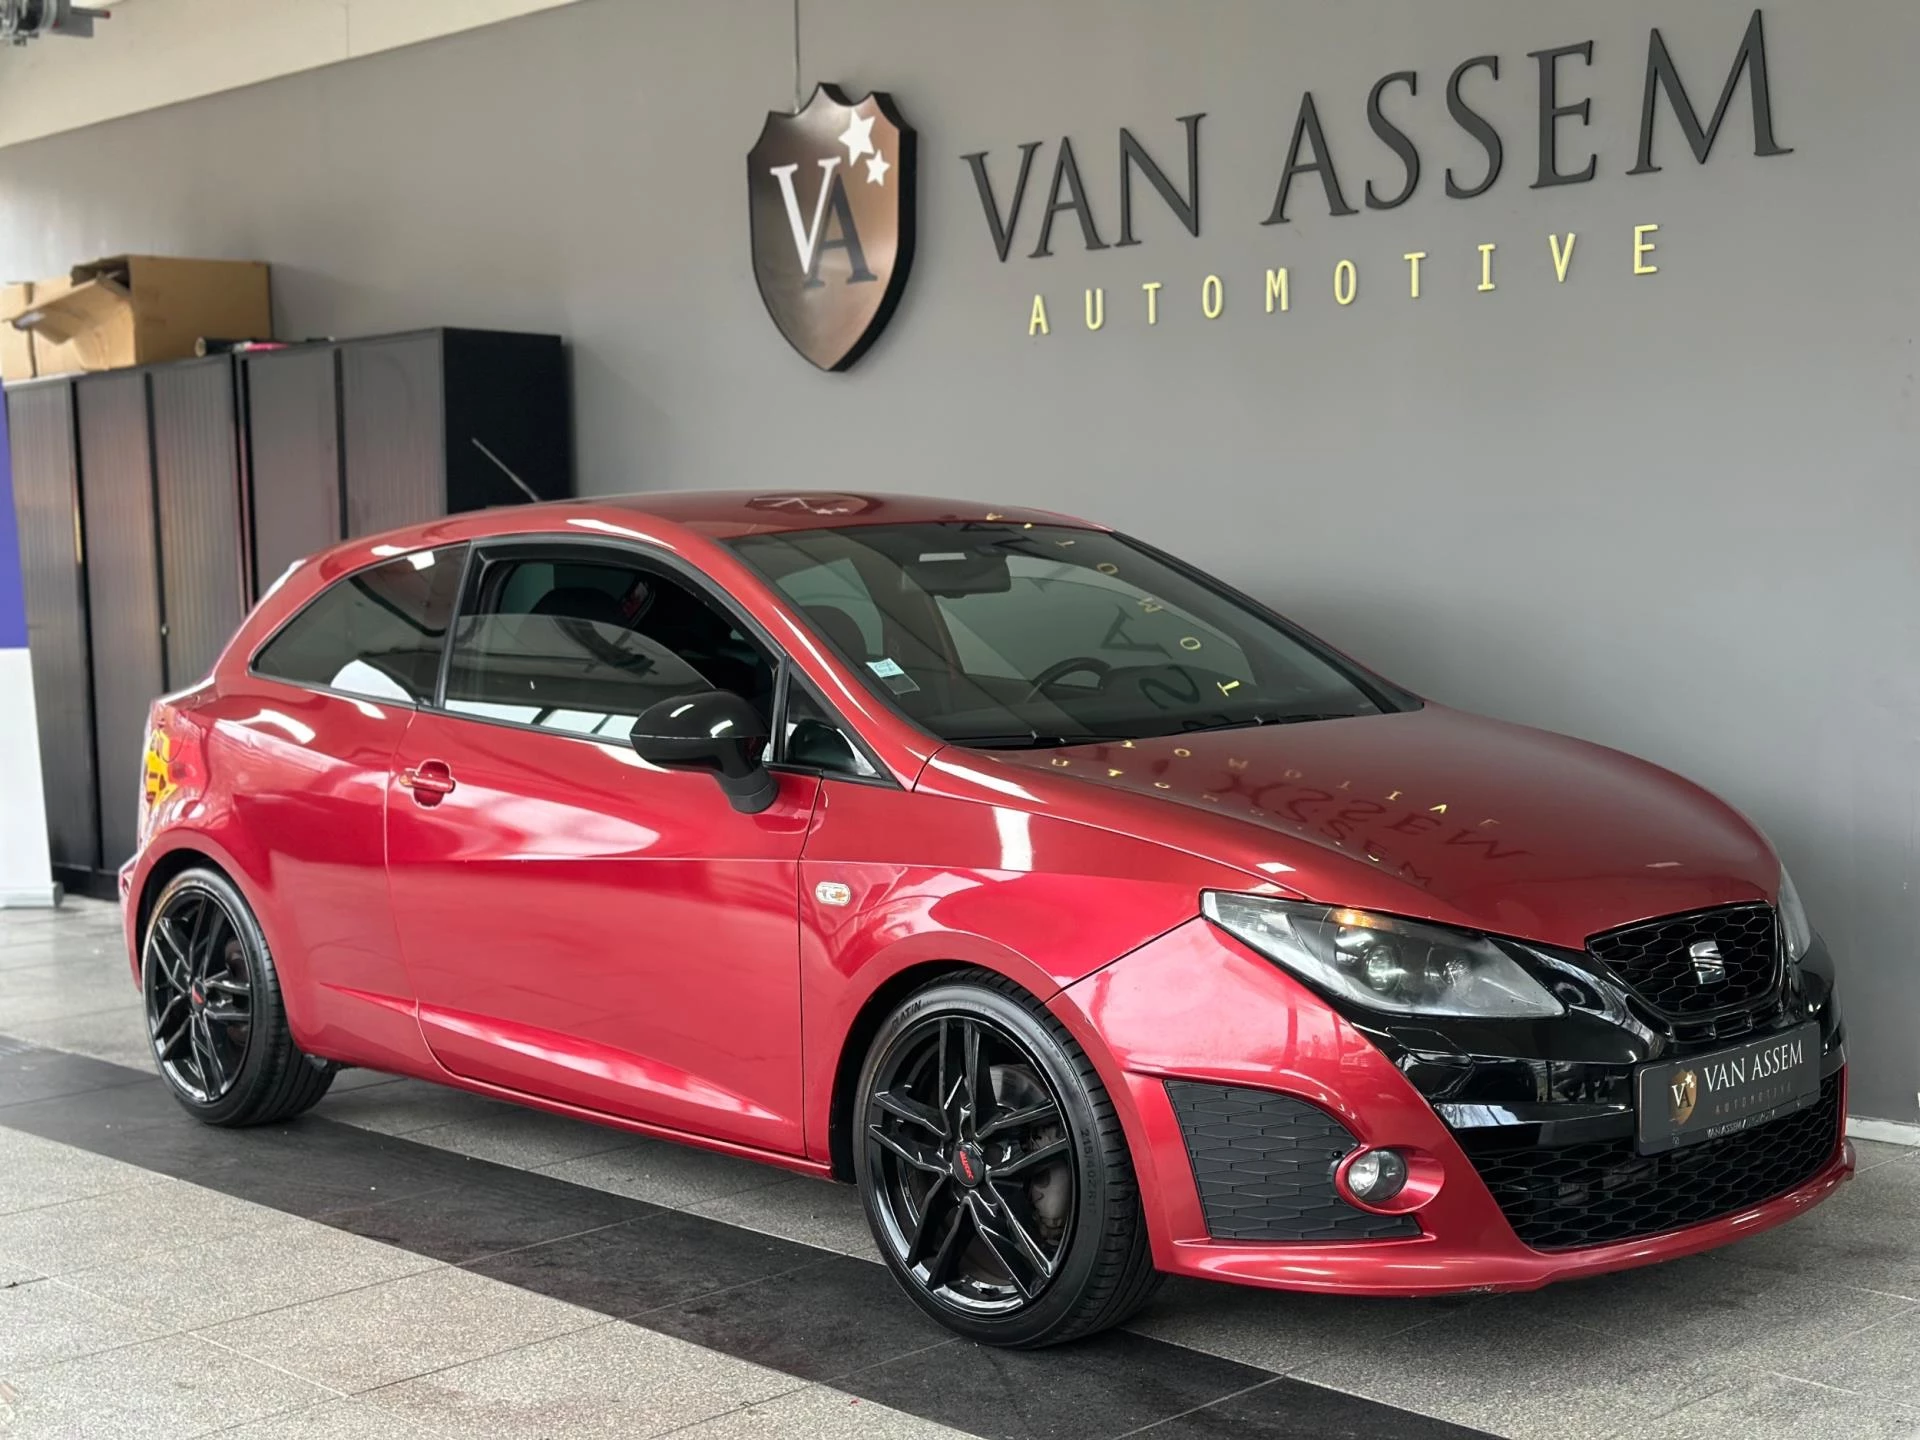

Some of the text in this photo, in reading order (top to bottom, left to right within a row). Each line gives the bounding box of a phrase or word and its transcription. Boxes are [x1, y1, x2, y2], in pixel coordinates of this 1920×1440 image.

[959, 8, 1795, 263] VAN ASSEM
[769, 155, 878, 289] VA
[1028, 223, 1660, 337] AUTOMOTIVE
[1671, 1082, 1692, 1109] VA
[1703, 1039, 1804, 1093] VAN ASSEM
